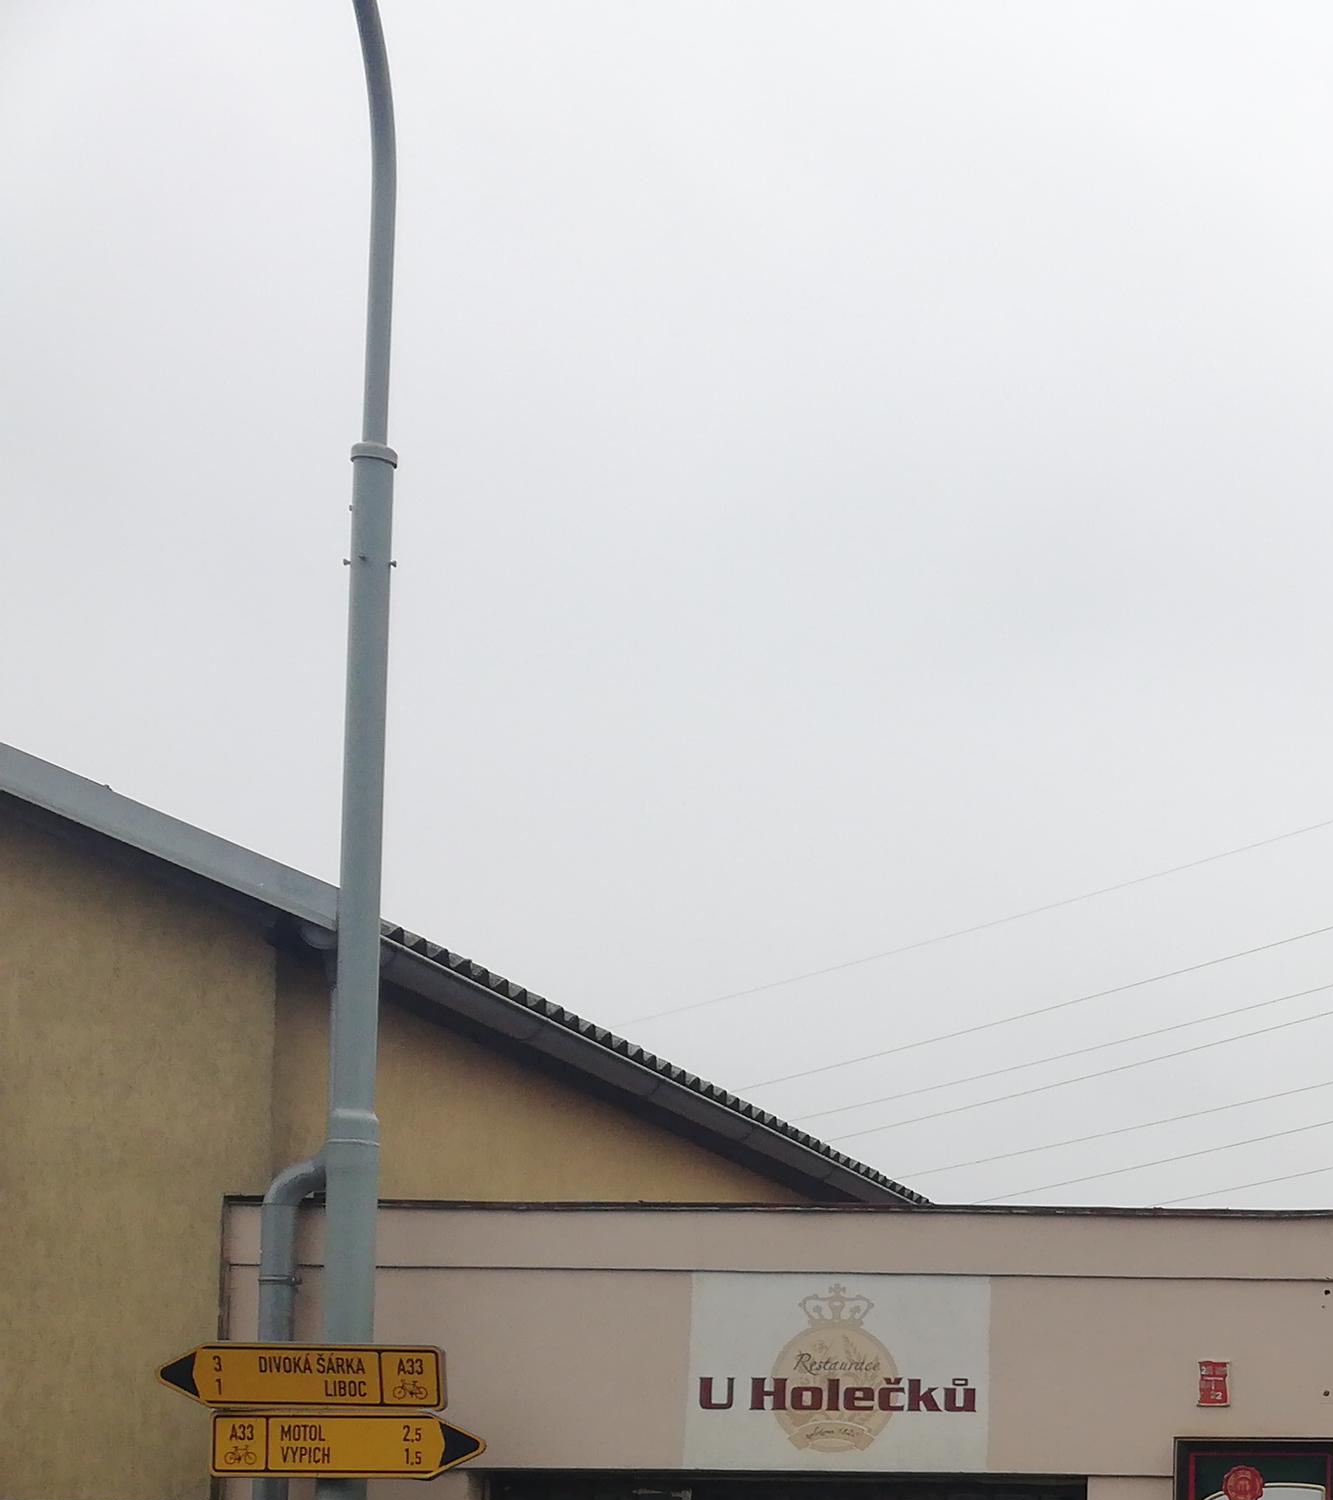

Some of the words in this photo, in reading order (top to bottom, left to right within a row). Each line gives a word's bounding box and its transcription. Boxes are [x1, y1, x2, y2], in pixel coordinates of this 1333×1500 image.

[212, 1355, 222, 1372] 3
[258, 1353, 312, 1374] DIVOKÁ
[316, 1353, 366, 1374] ŠÁRKA
[397, 1358, 424, 1376] A33
[792, 1352, 880, 1376] Restaurace
[215, 1378, 222, 1395] 1
[324, 1380, 367, 1397] LIBOC
[699, 1377, 735, 1410] U
[749, 1376, 977, 1413] Holečků
[230, 1424, 254, 1441] A33
[280, 1424, 325, 1442] MOTOL
[402, 1424, 422, 1443] 2,5
[281, 1447, 330, 1464] VYPICH
[404, 1447, 422, 1466] 1,5
